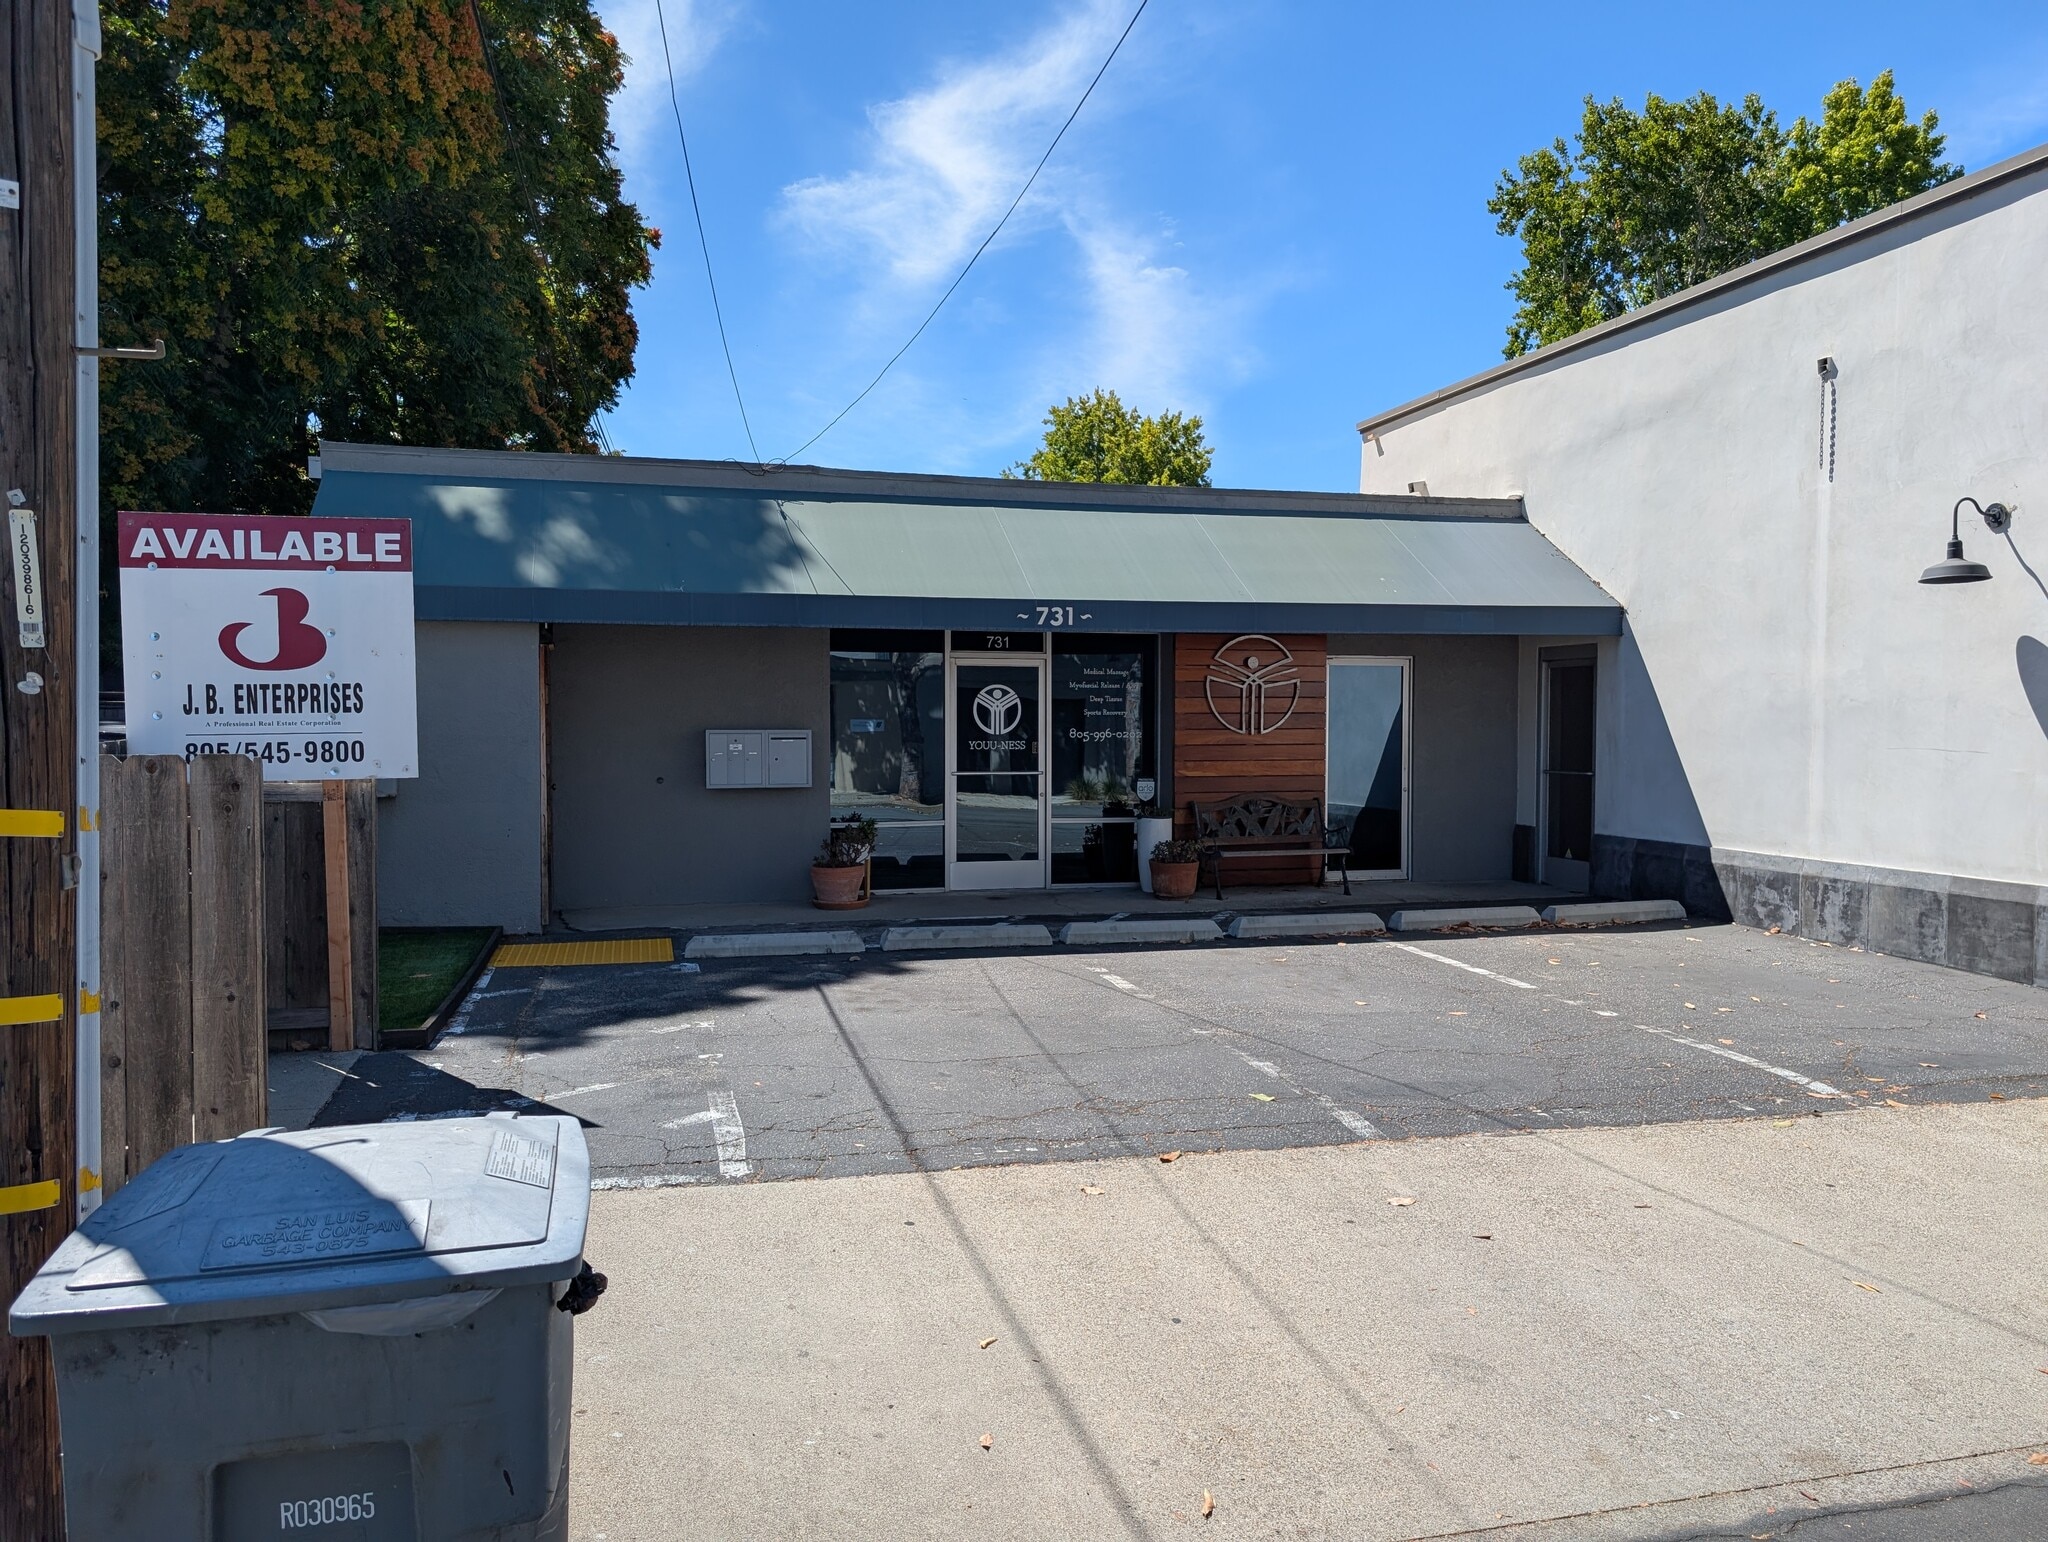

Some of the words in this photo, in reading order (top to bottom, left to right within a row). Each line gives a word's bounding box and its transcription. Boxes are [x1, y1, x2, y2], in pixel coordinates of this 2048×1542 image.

[130, 527, 402, 563] AVAILABLE
[986, 635, 1010, 649] 731
[1083, 667, 1105, 675] Medical
[234, 682, 364, 715] ENTERPRISES
[1089, 695, 1104, 704] Deep
[214, 720, 256, 728] Professional
[300, 719, 342, 728] Corporation
[968, 740, 1026, 751] YOUU-NESS
[275, 1217, 319, 1231] SAN
[324, 1209, 370, 1227] LUIS
[221, 1228, 314, 1249] GARBAGE
[317, 1217, 416, 1239] COMPANY
[279, 1491, 376, 1530] R030965
